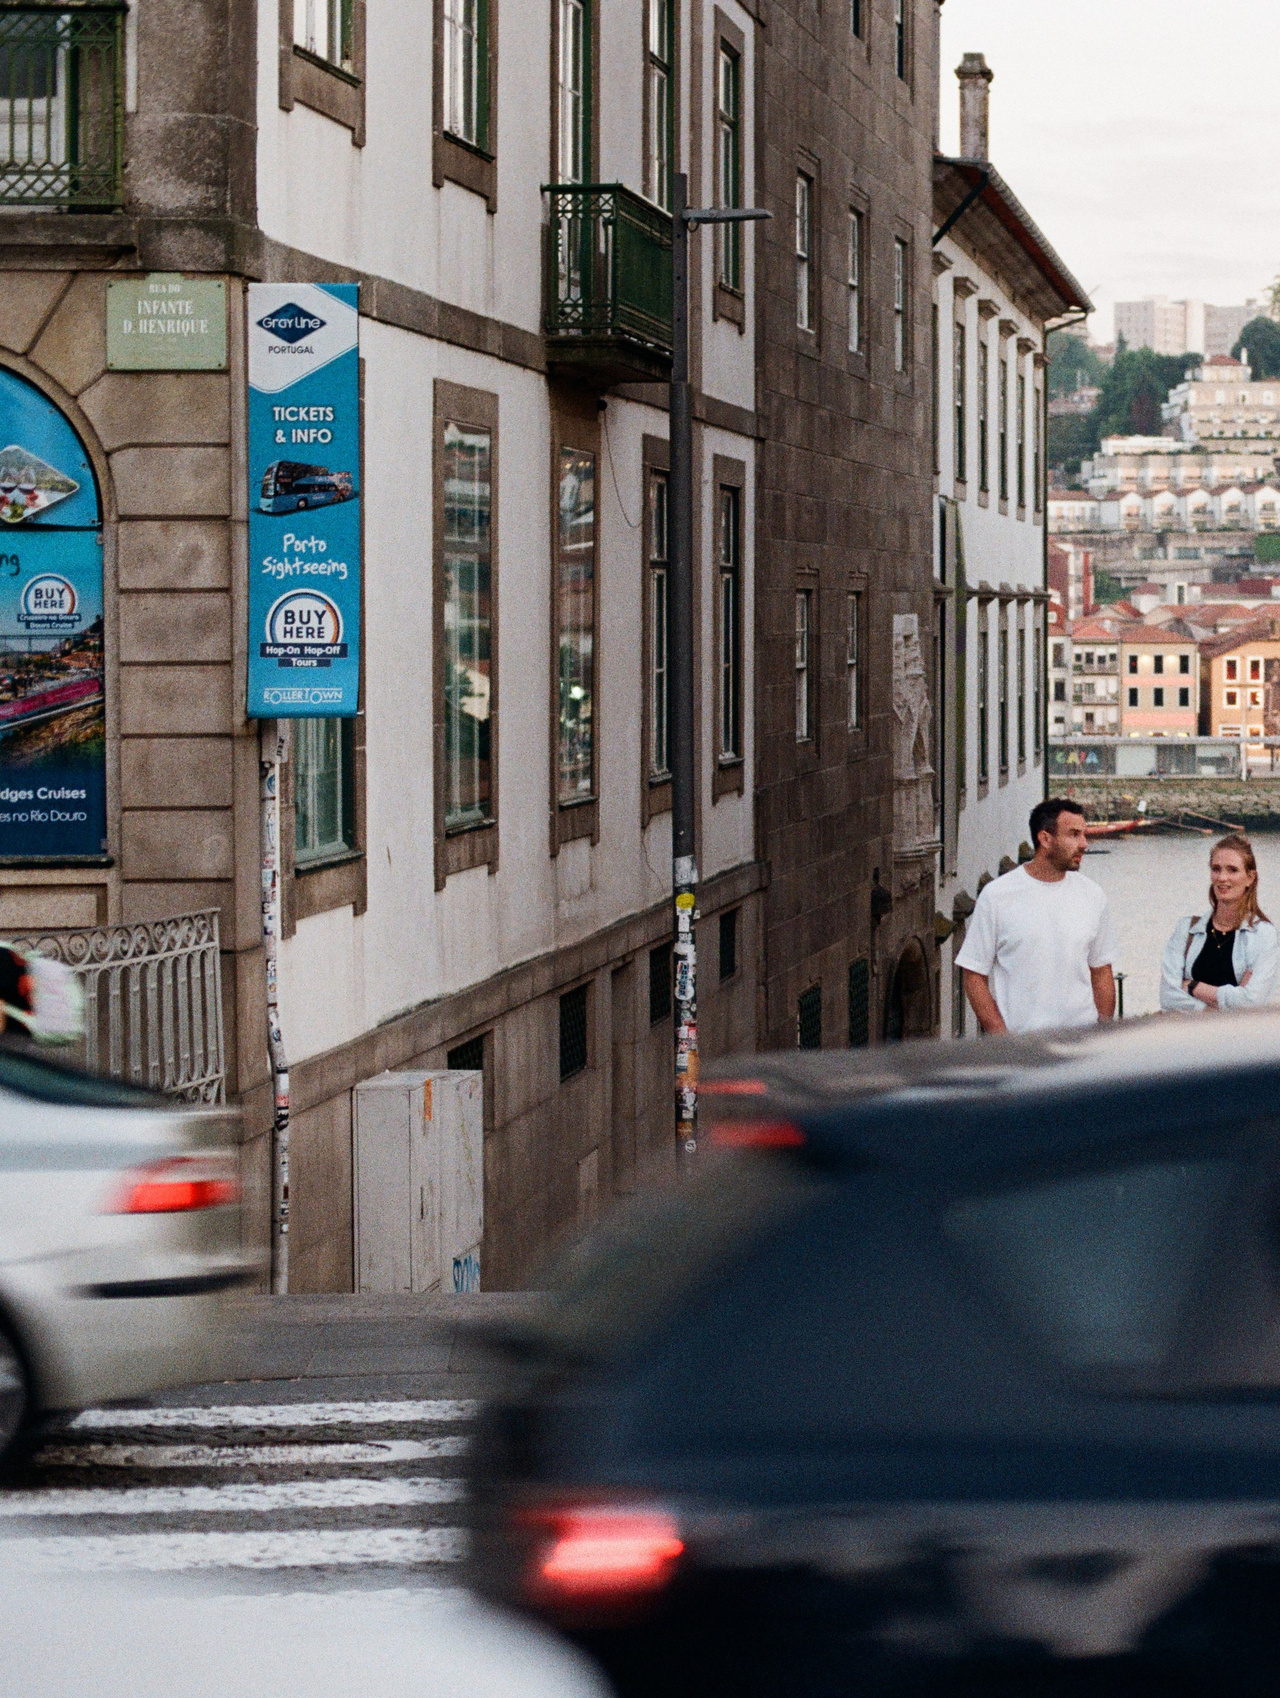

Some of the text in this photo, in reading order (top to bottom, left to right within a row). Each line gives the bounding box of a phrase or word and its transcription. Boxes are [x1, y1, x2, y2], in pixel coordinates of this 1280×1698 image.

[149, 283, 181, 293] RUA DO
[137, 300, 194, 315] INFANTE
[123, 319, 208, 337] D. HENRIQUE
[268, 346, 314, 354] PORTUGAL
[273, 407, 334, 421] TICKETS
[275, 428, 332, 443] & INFO
[283, 533, 327, 553] Porto
[262, 556, 348, 580] Sightseeing
[35, 588, 65, 599] BUY
[34, 600, 65, 608] HERE
[284, 610, 326, 625] BUY
[284, 627, 325, 639] HERE
[266, 646, 341, 656] Hop-On Hop-Off
[291, 658, 318, 667] Tours
[37, 787, 86, 799] Cruises
[12, 812, 29, 822] no
[30, 810, 49, 822] Rio
[50, 810, 87, 822] Douro
